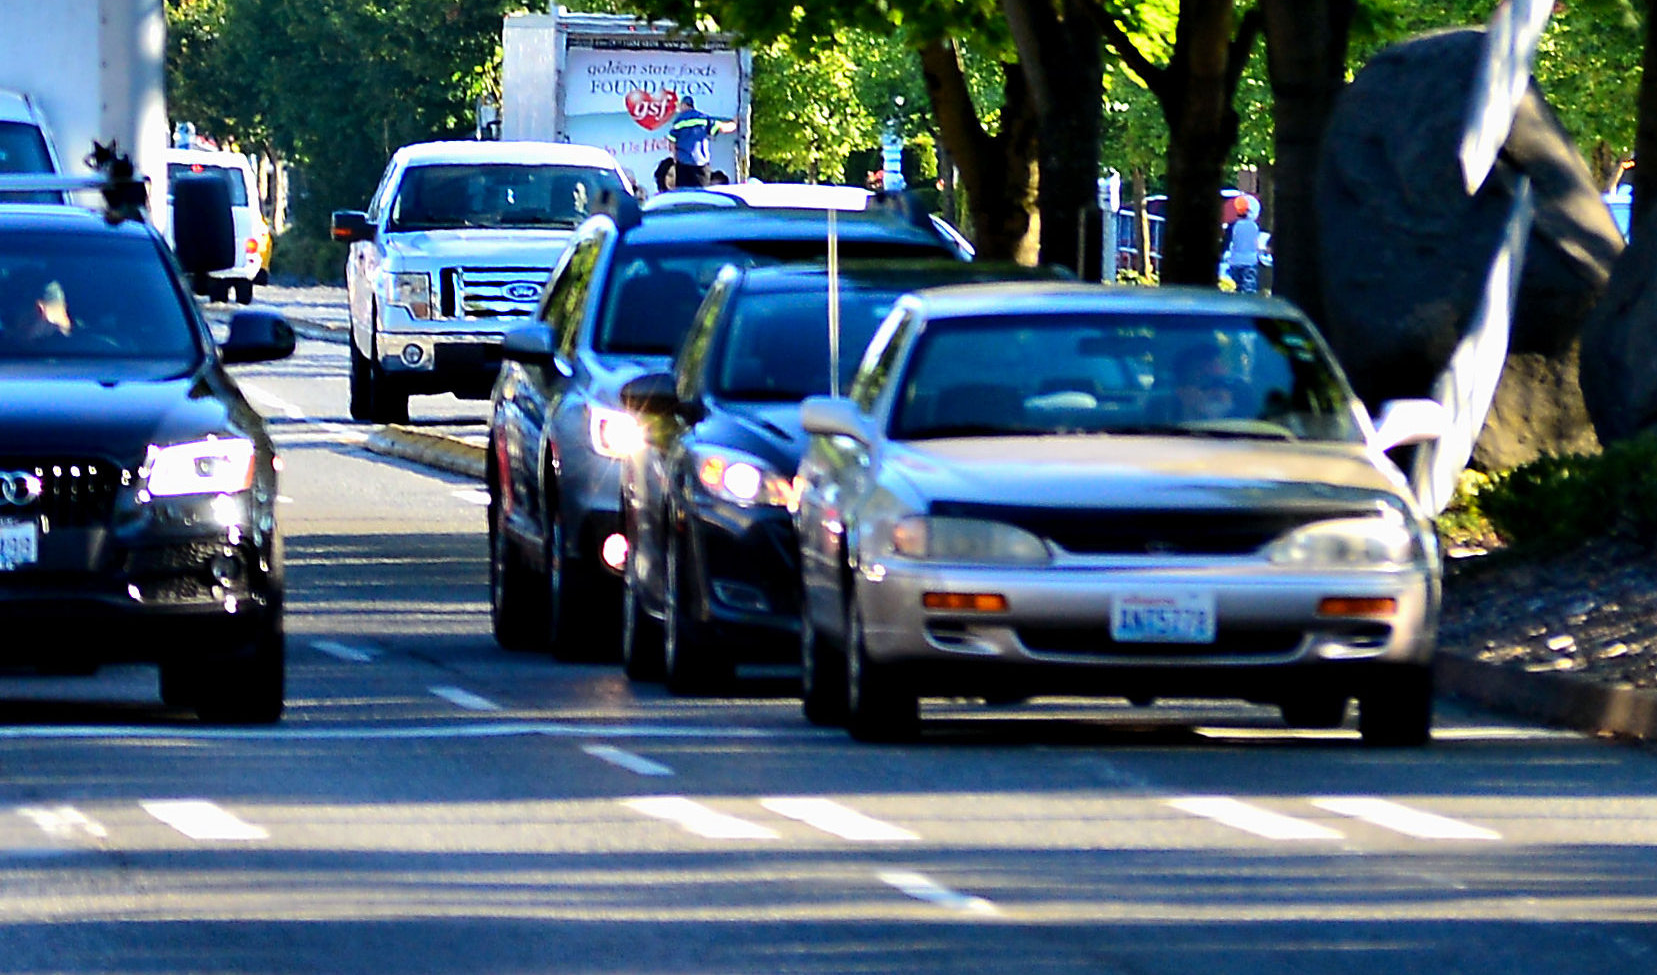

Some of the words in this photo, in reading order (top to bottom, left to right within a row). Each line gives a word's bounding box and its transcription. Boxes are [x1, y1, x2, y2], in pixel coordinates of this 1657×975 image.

[587, 59, 637, 76] golden
[641, 62, 676, 75] state
[676, 63, 718, 78] foods
